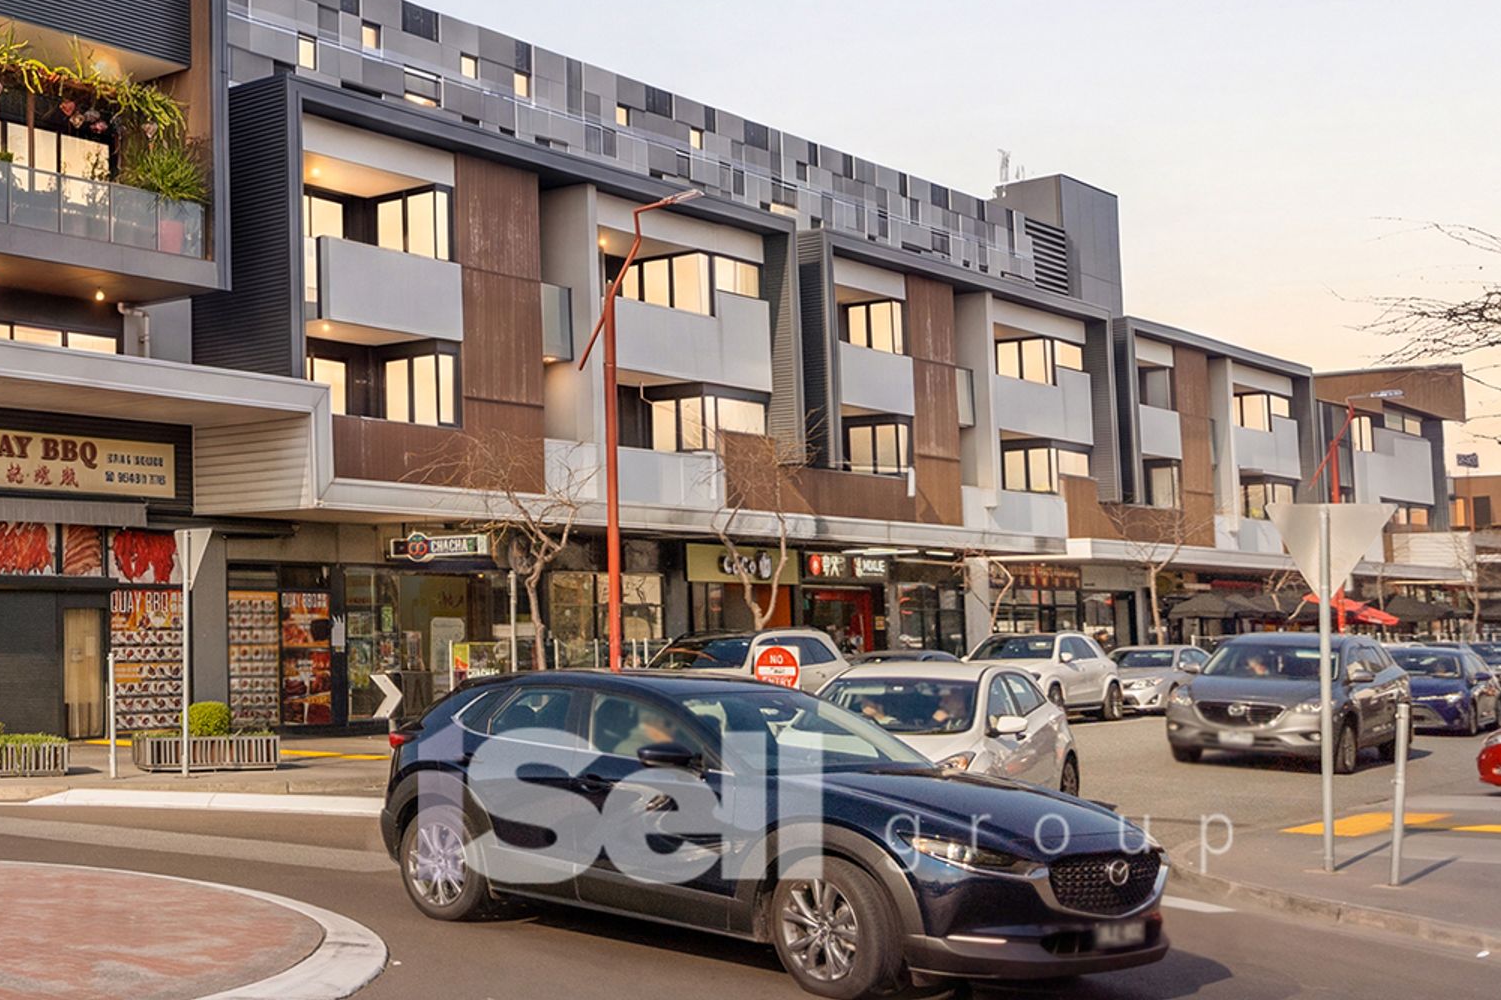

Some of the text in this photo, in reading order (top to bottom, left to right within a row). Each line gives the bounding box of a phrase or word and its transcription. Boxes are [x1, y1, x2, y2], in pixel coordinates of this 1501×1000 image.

[41, 438, 98, 470] BBQ
[110, 591, 142, 613] QUAY
[145, 592, 168, 613] BBQ
[769, 654, 784, 665] NO
